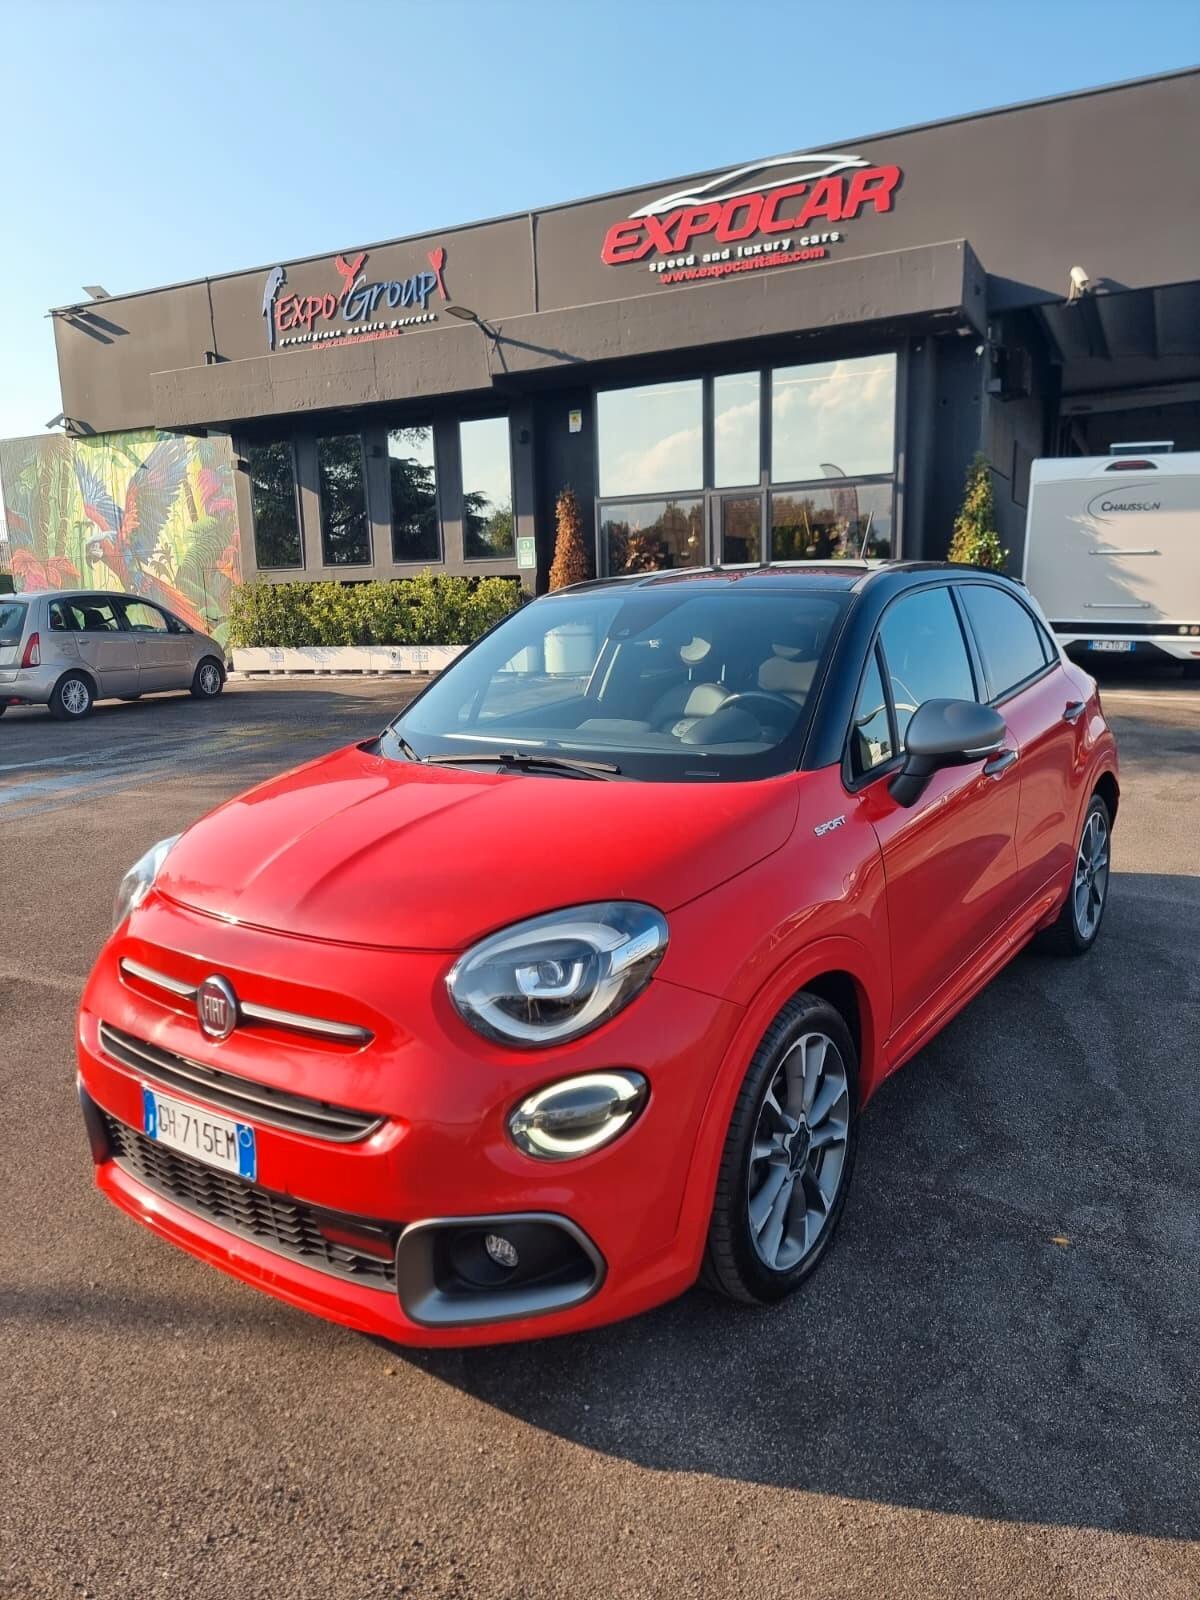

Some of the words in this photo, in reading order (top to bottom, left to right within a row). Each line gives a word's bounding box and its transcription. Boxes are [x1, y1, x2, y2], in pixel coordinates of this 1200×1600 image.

[601, 165, 900, 264] EXPOCAR
[649, 254, 695, 272] speed
[702, 249, 730, 263] and
[737, 238, 791, 258] luxury
[799, 230, 840, 247] cars
[814, 815, 846, 836] SPORT
[203, 995, 225, 1025] FIAT
